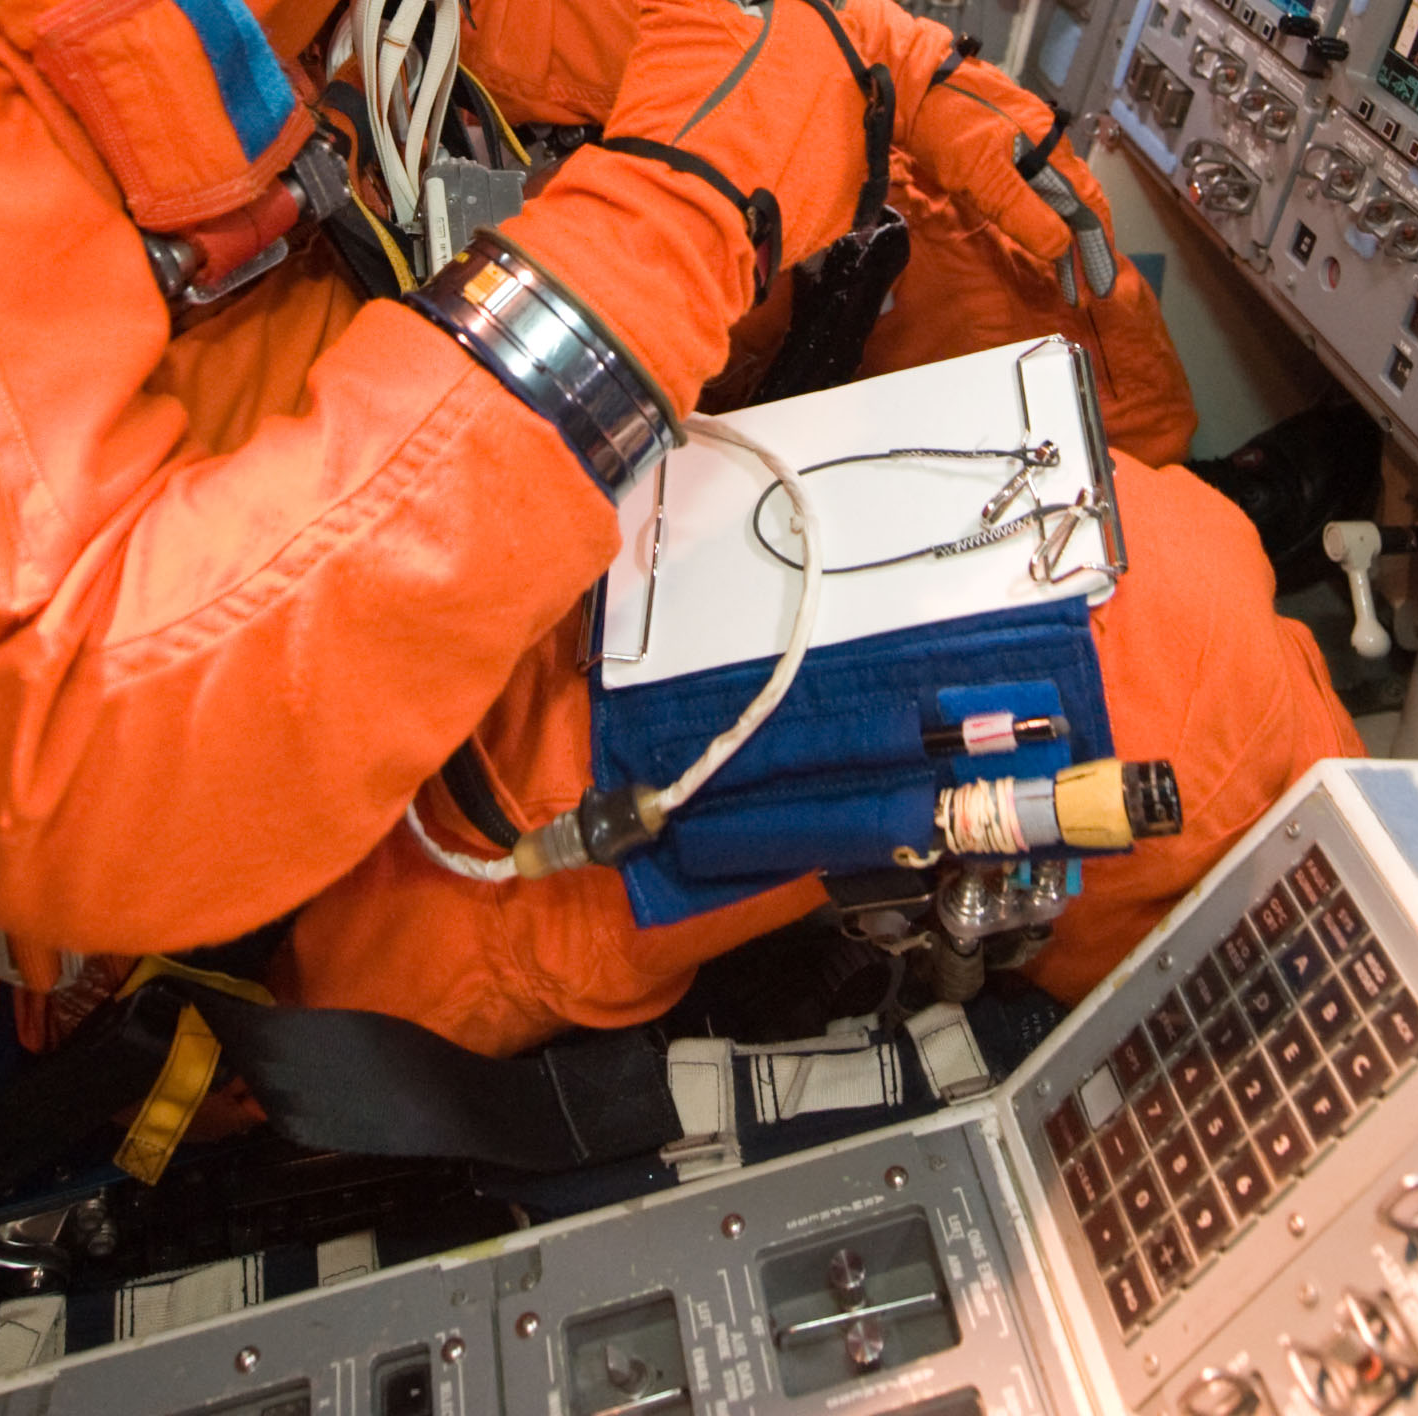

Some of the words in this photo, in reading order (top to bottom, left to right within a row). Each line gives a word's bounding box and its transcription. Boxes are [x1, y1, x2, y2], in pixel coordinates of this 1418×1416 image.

[1292, 950, 1312, 976] A
[1319, 998, 1340, 1024] B
[1389, 1009, 1415, 1044] ACK
[1281, 1039, 1301, 1065] E
[1349, 1050, 1372, 1080] C
[1181, 1061, 1198, 1085] 4
[1243, 1076, 1263, 1102] 2
[1146, 1099, 1163, 1123] 7
[1311, 1094, 1331, 1120] F
[1206, 1114, 1224, 1139] 5
[1270, 1130, 1292, 1159] 3
[1170, 1151, 1189, 1176] 8
[1074, 1160, 1096, 1202] CLEAR
[1234, 1171, 1254, 1198] 6
[1133, 1186, 1151, 1212] 0
[1194, 1206, 1214, 1234] 9
[967, 1227, 988, 1260] OMS
[1156, 1238, 1177, 1271] +
[1118, 1276, 1139, 1315] PRO
